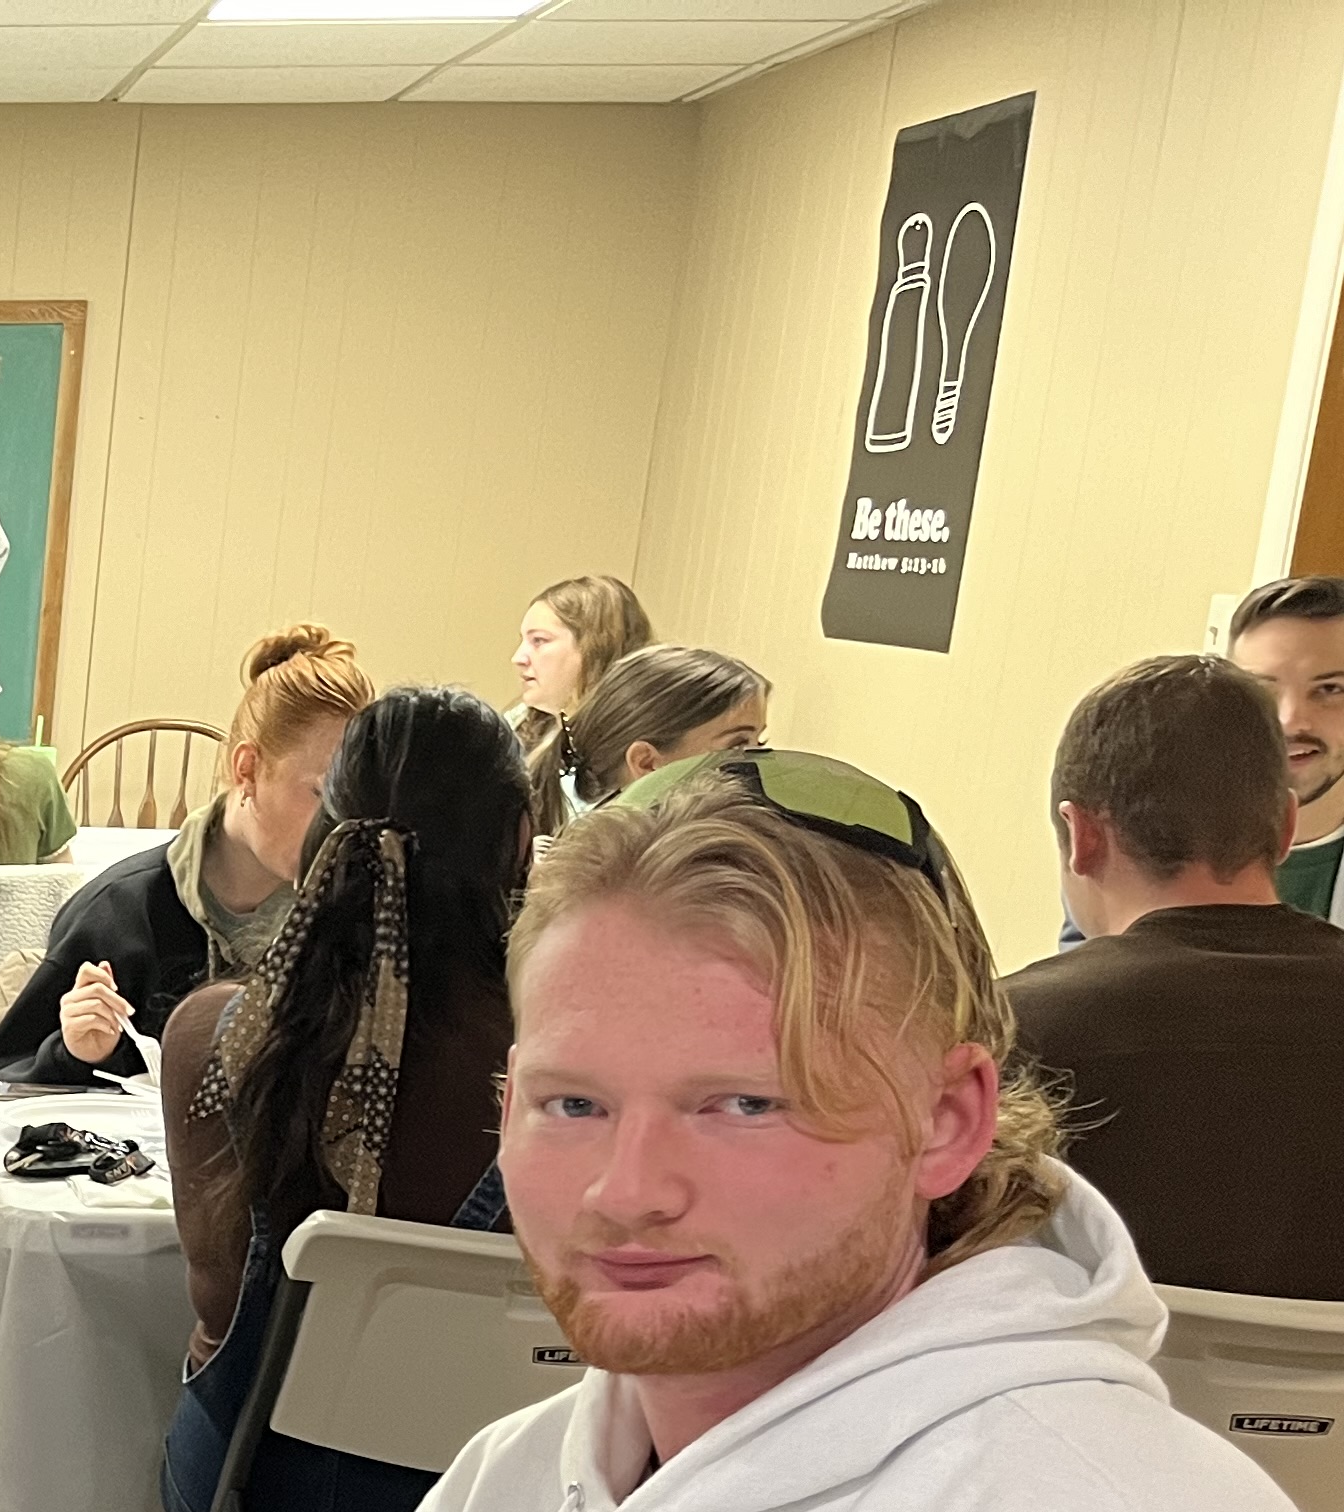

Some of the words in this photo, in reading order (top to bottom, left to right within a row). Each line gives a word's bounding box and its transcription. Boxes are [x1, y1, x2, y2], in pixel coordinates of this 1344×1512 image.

[850, 497, 882, 541] Be
[884, 498, 950, 543] these.
[846, 552, 899, 571] Matthew
[1242, 1418, 1321, 1433] LIFETIME
